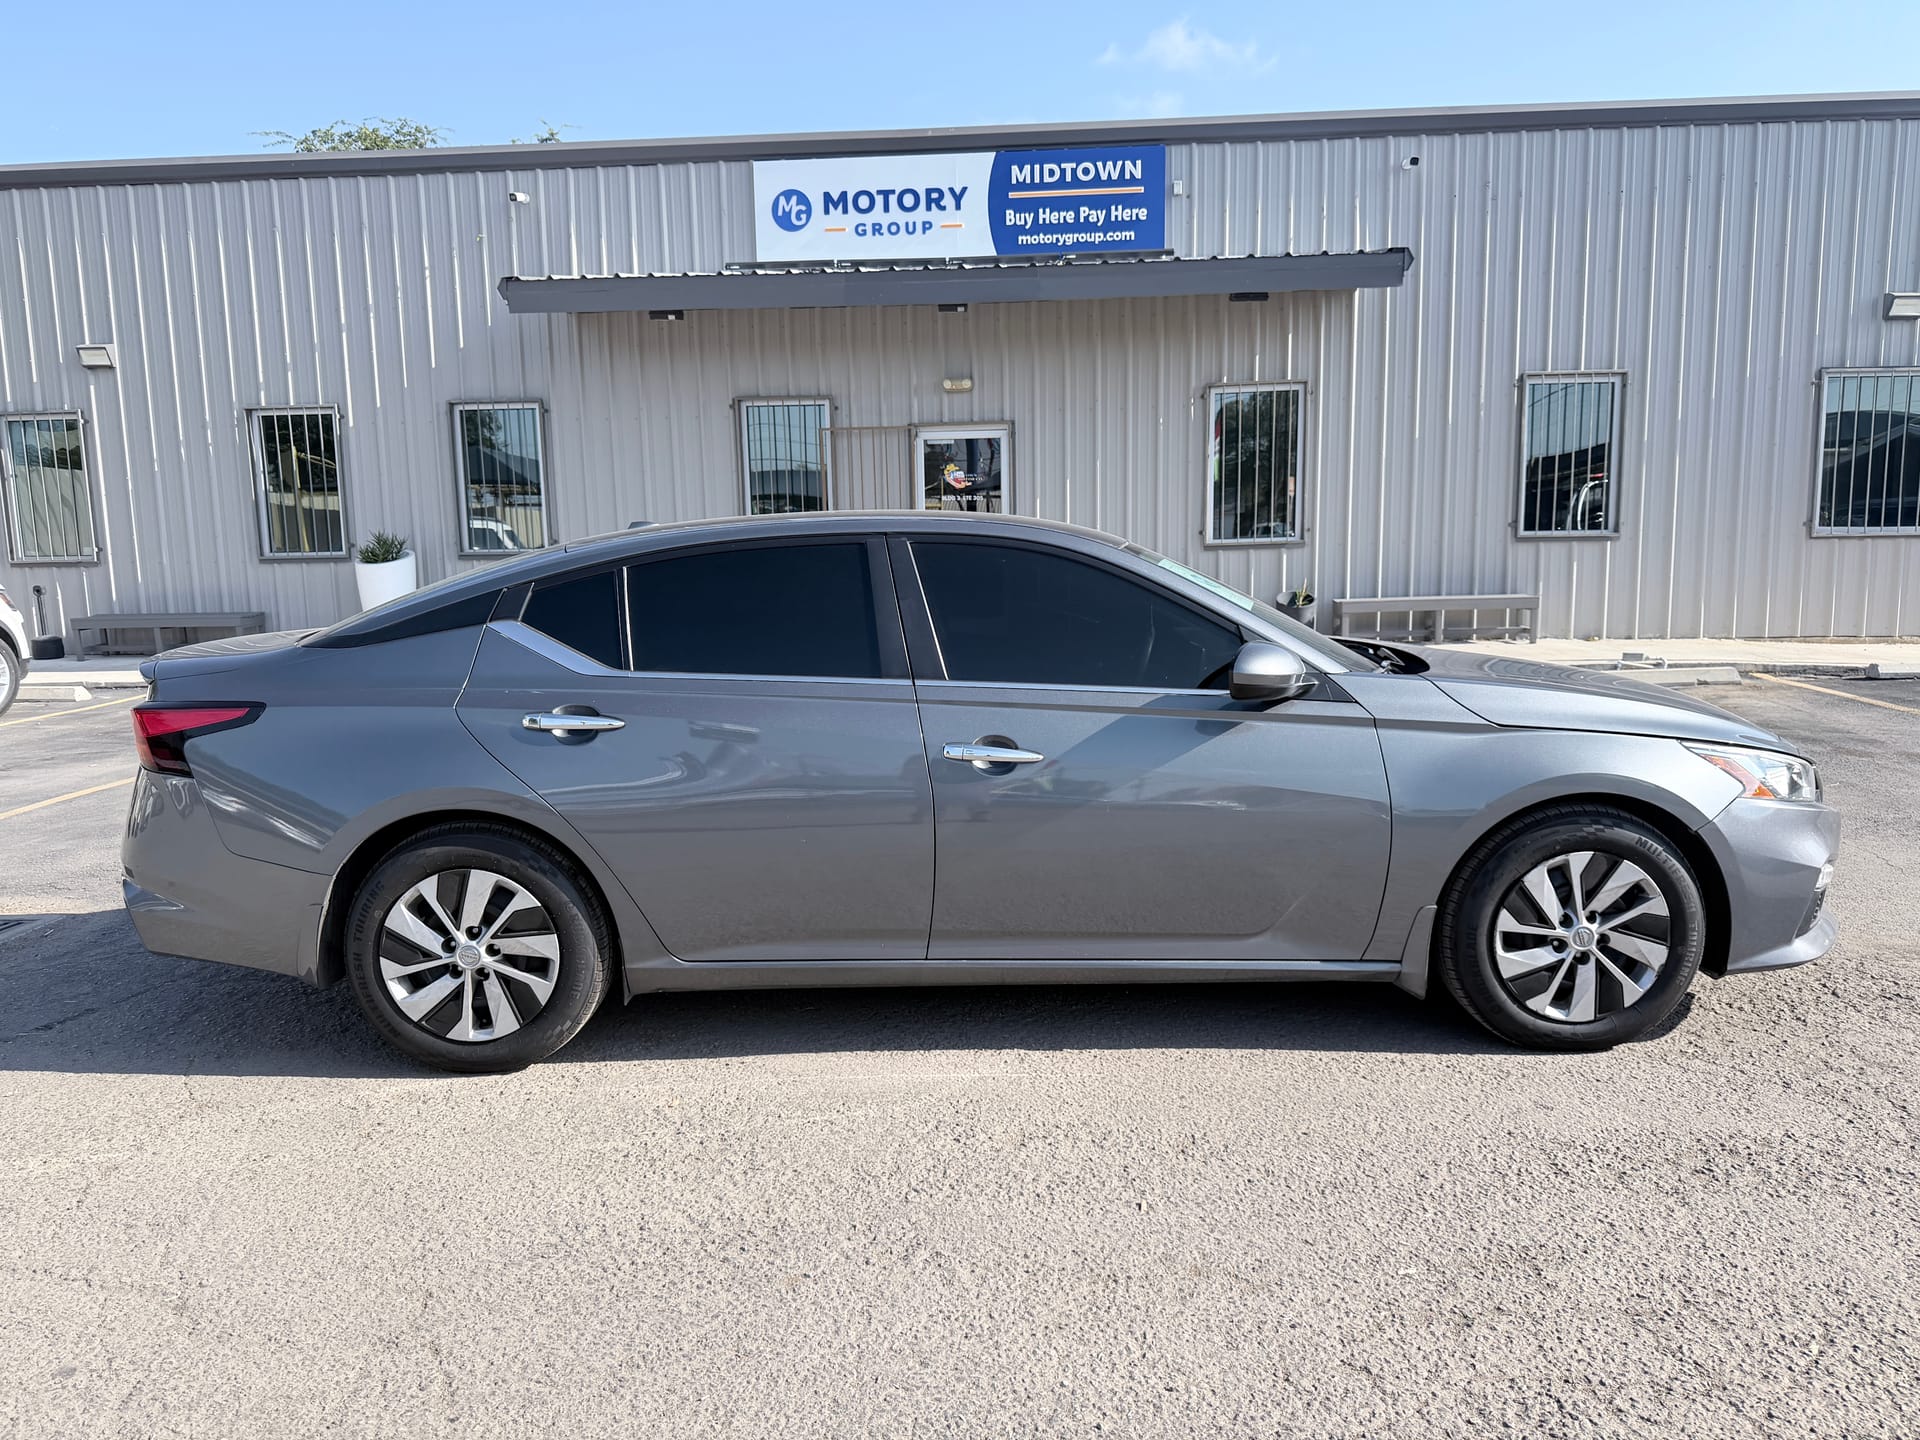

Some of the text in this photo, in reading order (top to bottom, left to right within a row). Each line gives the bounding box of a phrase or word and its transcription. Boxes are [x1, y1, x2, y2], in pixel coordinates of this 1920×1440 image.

[1011, 160, 1142, 185] MIDTOWN
[777, 195, 807, 226] MG
[823, 186, 968, 215] MOTORY
[854, 220, 933, 237] GROUP
[1005, 204, 1148, 229] Buy Here Pay Here
[1018, 230, 1135, 245] motorygroup.com
[353, 880, 385, 943] TOURING
